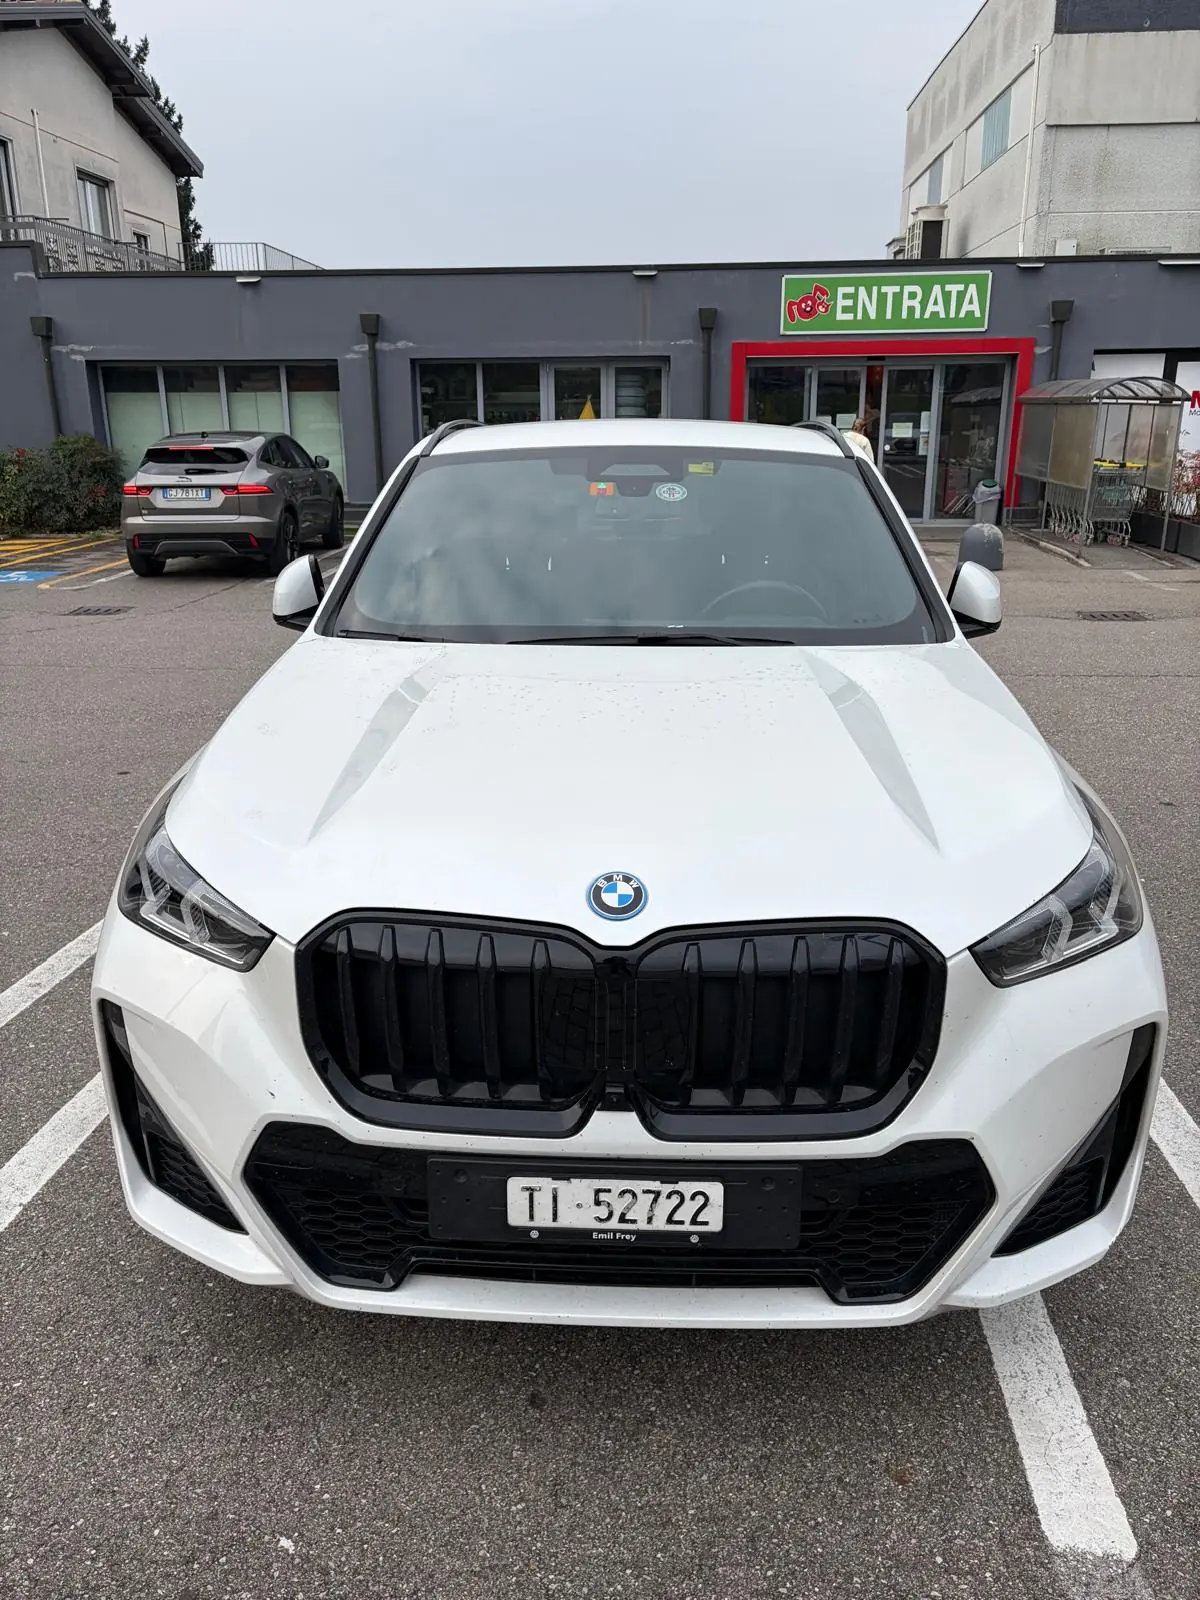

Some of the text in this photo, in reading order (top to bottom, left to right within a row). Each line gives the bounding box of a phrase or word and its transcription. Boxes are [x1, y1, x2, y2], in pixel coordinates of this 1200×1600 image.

[835, 283, 981, 321] ENTRATA
[597, 874, 640, 888] BMW
[520, 1185, 710, 1226] TI 52722
[592, 1231, 637, 1242] Emil Frey
